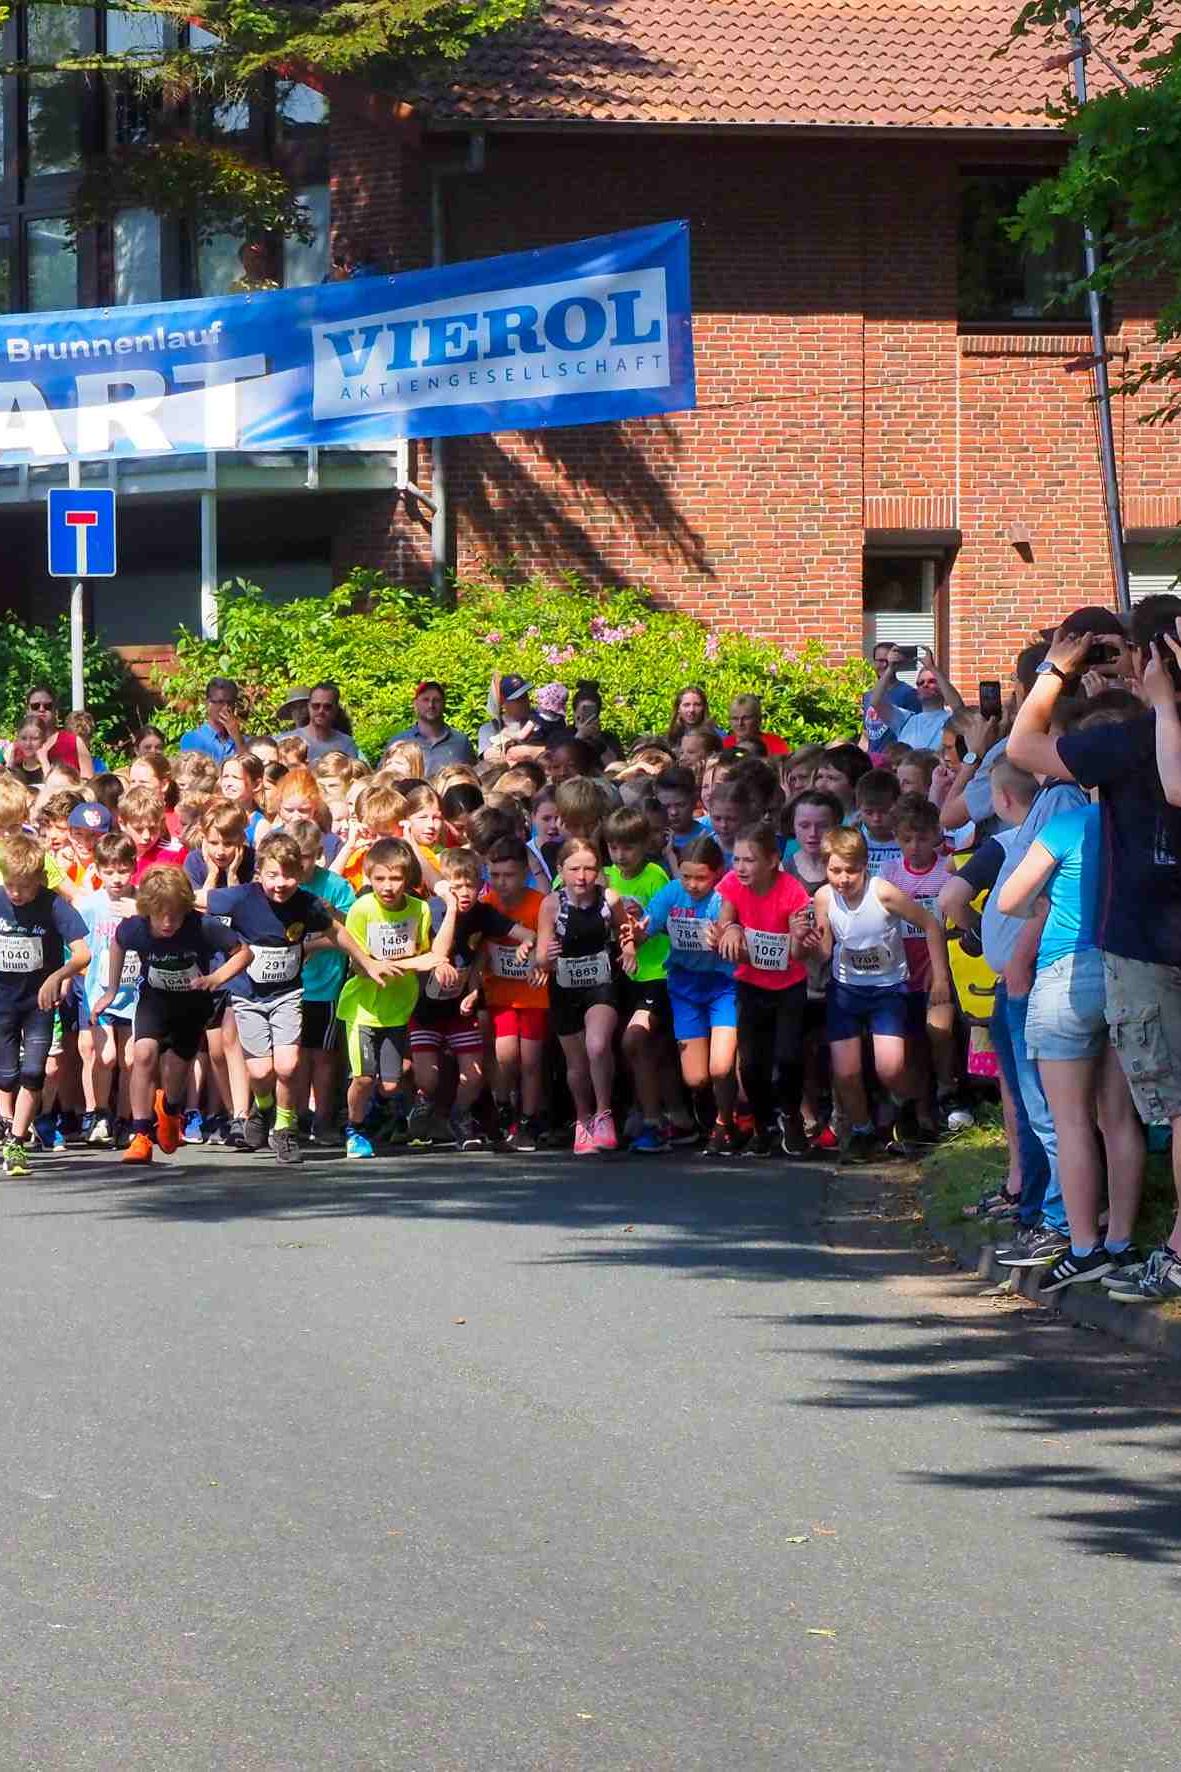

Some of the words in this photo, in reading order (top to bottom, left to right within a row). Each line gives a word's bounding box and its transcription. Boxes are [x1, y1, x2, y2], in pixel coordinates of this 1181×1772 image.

[6, 320, 224, 363] Brunnenlauf
[322, 290, 662, 378] VIEROL
[340, 354, 663, 400] AKTIENGESELLSCHAFT
[1, 950, 30, 959] 1040
[755, 945, 785, 956] 1067
[265, 960, 286, 970] 291
